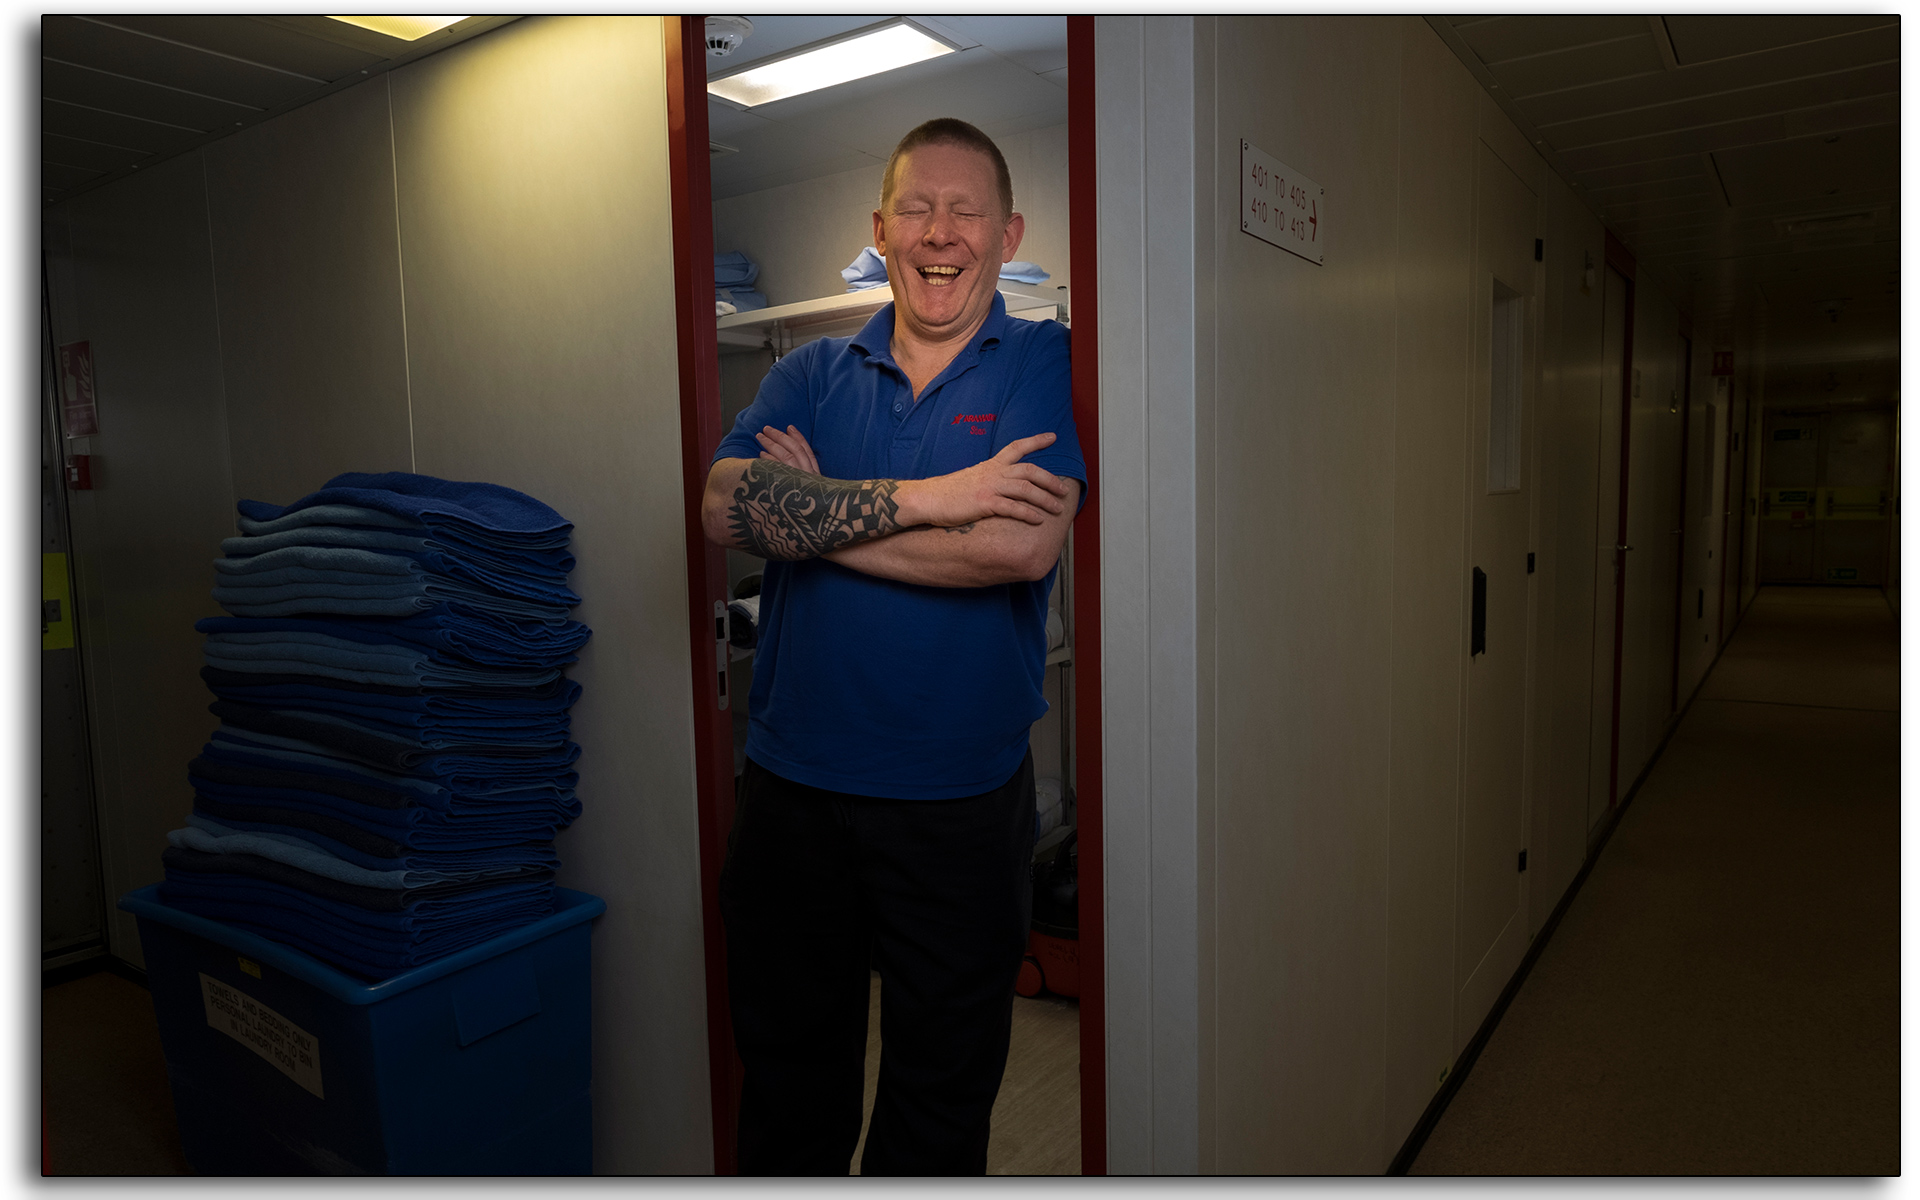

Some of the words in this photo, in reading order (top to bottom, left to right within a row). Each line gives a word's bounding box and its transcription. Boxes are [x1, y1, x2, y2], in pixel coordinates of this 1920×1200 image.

[1252, 163, 1268, 190] 401
[1274, 175, 1285, 199] TO
[1290, 185, 1306, 210] 405
[1251, 197, 1267, 223] 410
[1274, 208, 1285, 231] TO
[1291, 217, 1305, 241] 413
[207, 981, 239, 1006] TOWELS
[242, 999, 257, 1016] AND
[259, 1008, 290, 1038] BEDDING
[292, 1031, 311, 1052] ONLY
[210, 996, 250, 1027] PERSONAL
[252, 1018, 284, 1049] LAUNDRY
[287, 1041, 297, 1058] TO
[300, 1050, 313, 1069] BIN
[230, 1019, 238, 1032] IN
[241, 1025, 272, 1054] LAUNDRY
[275, 1047, 296, 1072] ROOM
